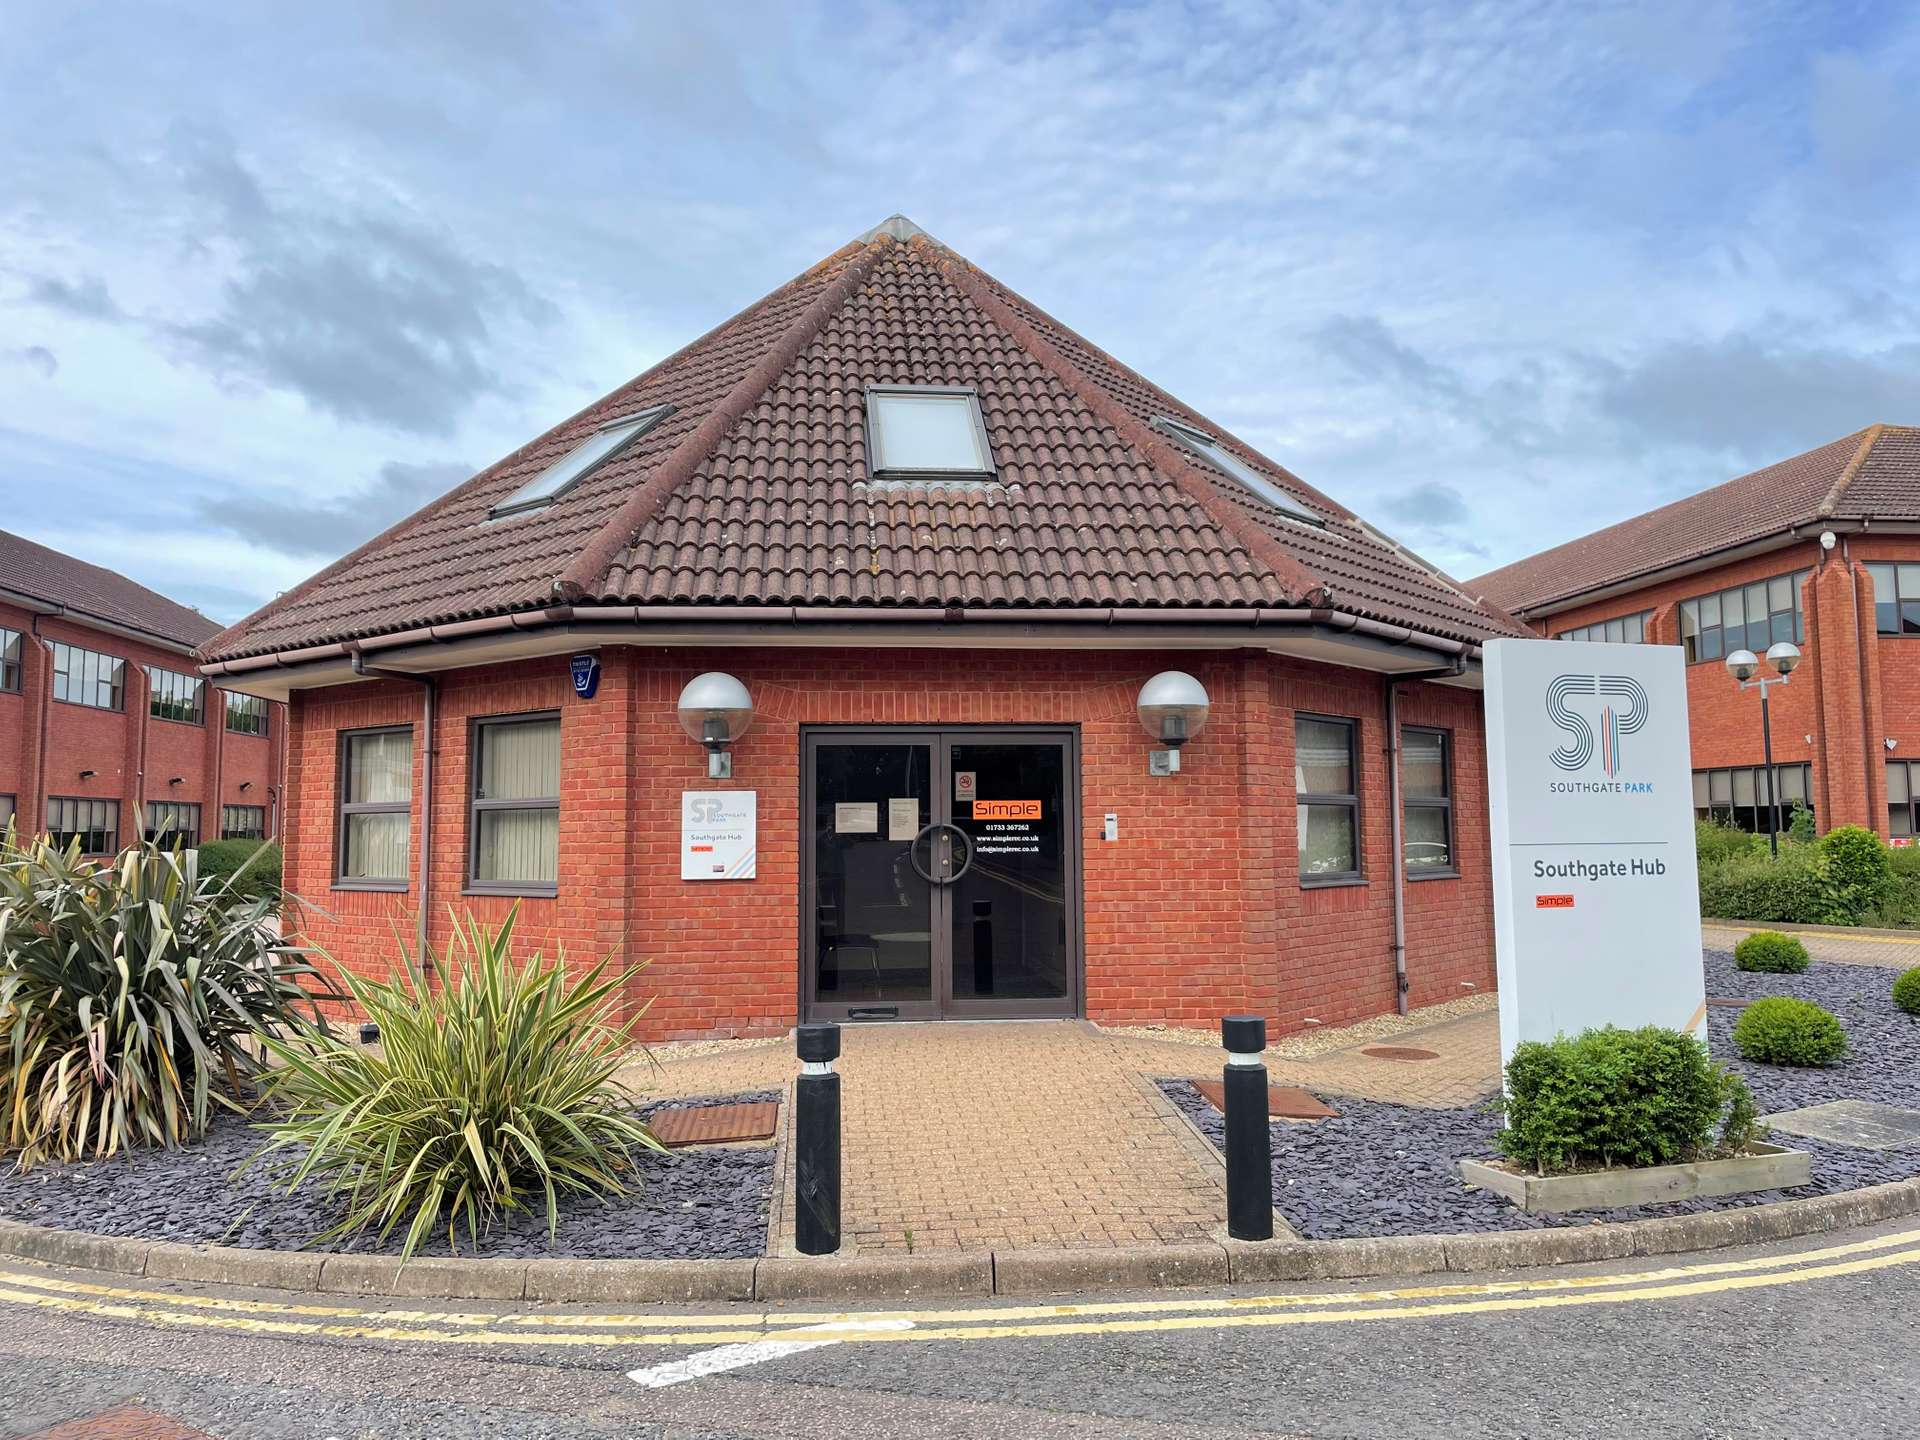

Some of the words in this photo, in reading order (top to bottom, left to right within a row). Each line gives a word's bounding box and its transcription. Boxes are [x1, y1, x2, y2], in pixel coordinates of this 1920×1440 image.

[1546, 674, 1648, 779] SP
[1550, 782, 1621, 793] SOUTHGATE
[1625, 783, 1653, 793] PARK
[975, 803, 1038, 817] Simple
[690, 833, 727, 842] Southgate
[728, 832, 742, 841] Hub
[1534, 860, 1627, 881] Southgate
[1632, 858, 1666, 876] Hub
[1536, 896, 1574, 907] Simple
